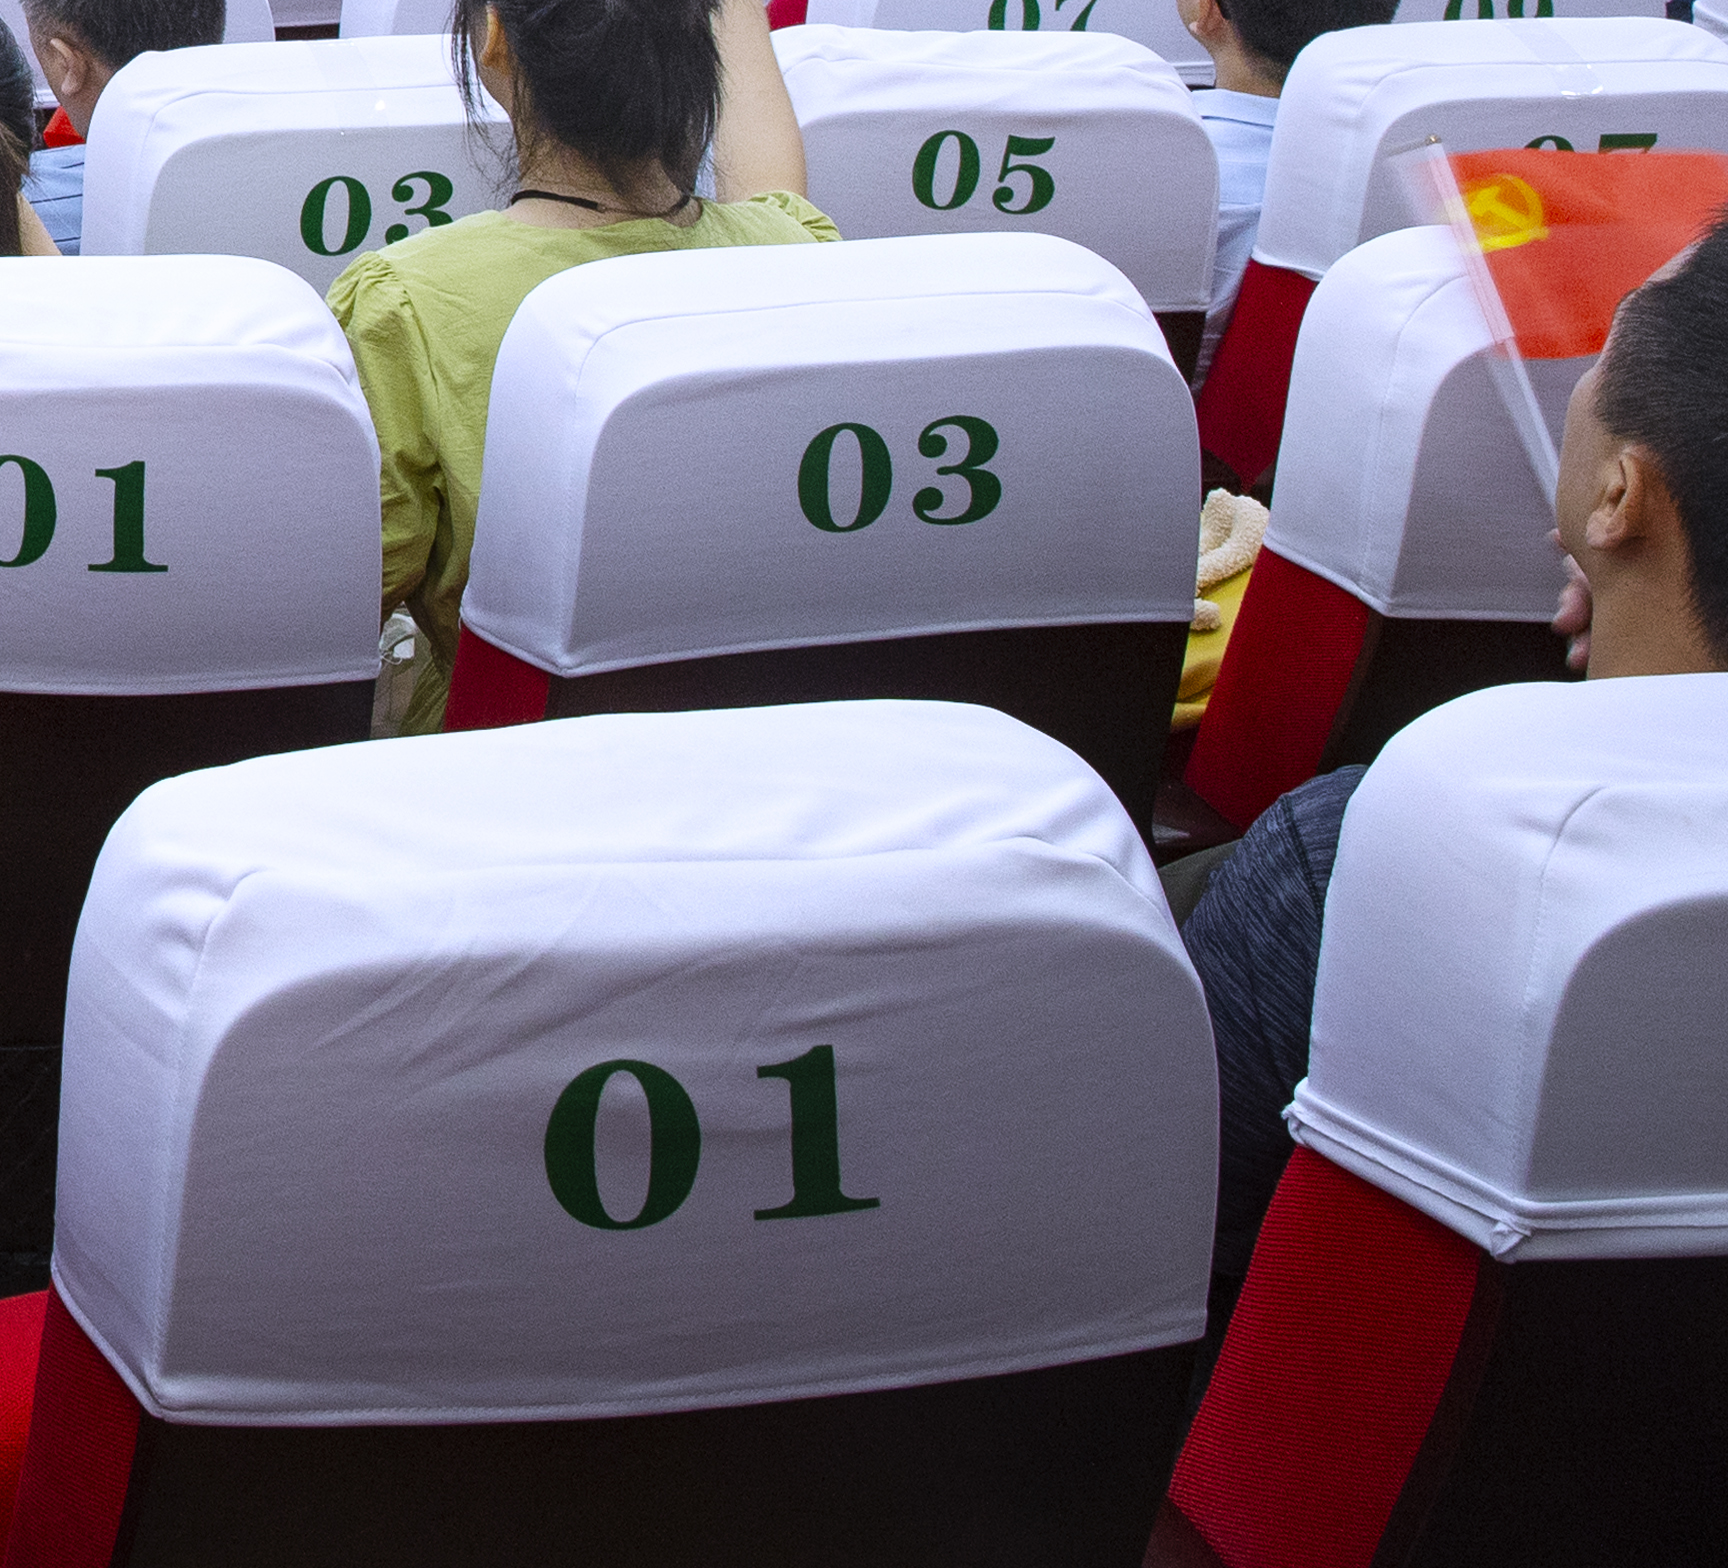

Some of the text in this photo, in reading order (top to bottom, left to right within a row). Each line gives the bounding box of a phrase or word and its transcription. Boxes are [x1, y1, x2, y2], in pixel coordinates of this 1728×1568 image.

[300, 171, 455, 257] 03
[913, 131, 1056, 215] 05
[799, 415, 1003, 534] 03
[545, 1044, 881, 1231] 01
